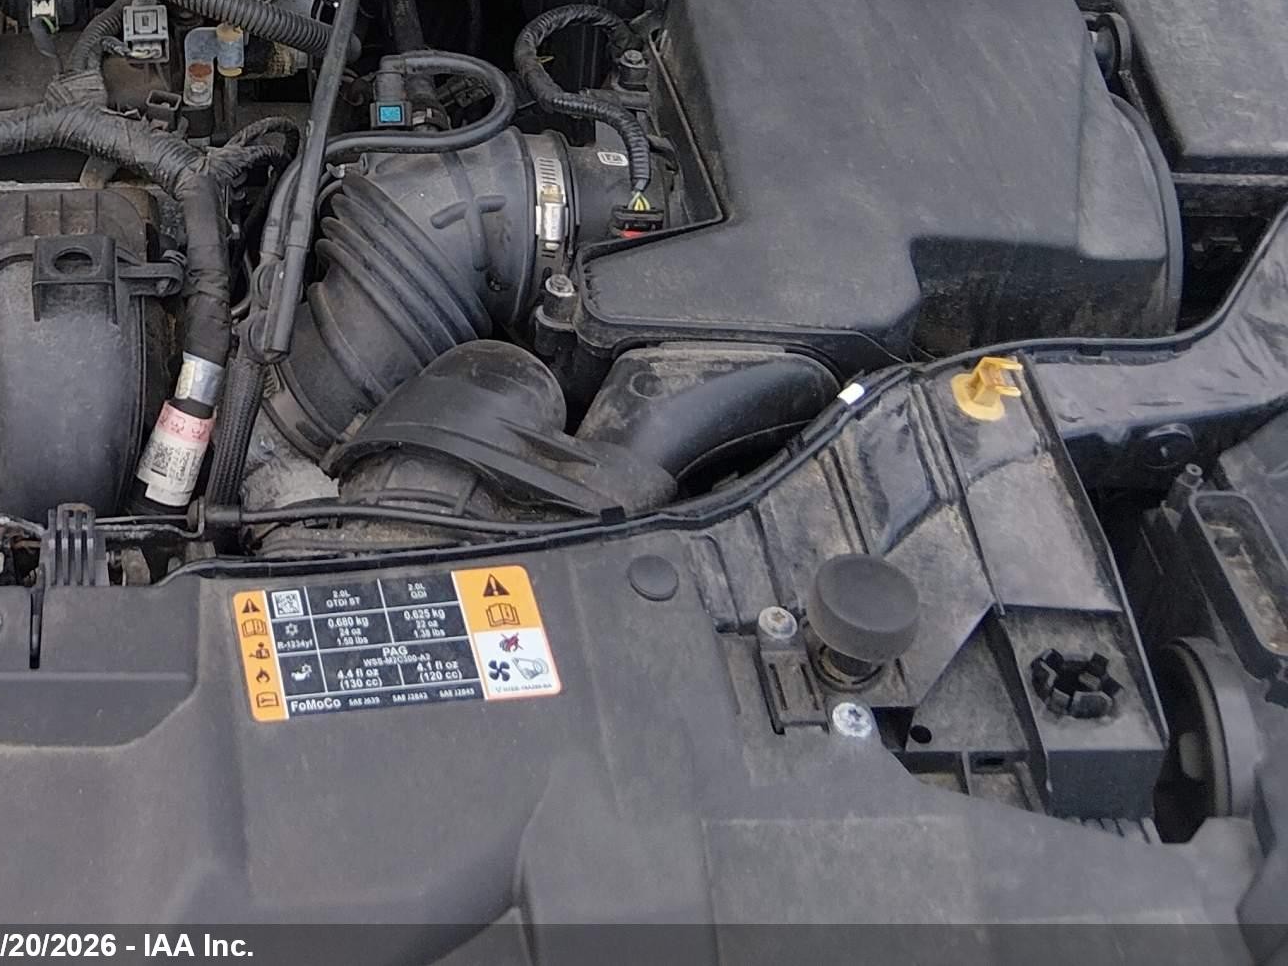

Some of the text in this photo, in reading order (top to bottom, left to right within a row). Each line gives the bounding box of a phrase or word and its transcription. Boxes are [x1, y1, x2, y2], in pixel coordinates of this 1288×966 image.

[404, 608, 445, 621] 0.625 kg
[327, 615, 369, 628] 0.680 kg
[427, 620, 439, 628] oz
[350, 627, 362, 636] oz
[277, 638, 313, 651] R-1234yf
[355, 636, 369, 645] lbs
[382, 645, 409, 656] PAG
[416, 660, 459, 672] 4.1 fl oz
[337, 667, 380, 679] 4.4 fl oz
[419, 669, 463, 683] (120 cc)
[340, 676, 383, 691] (130 cc)
[291, 697, 342, 712] FoMoCo
